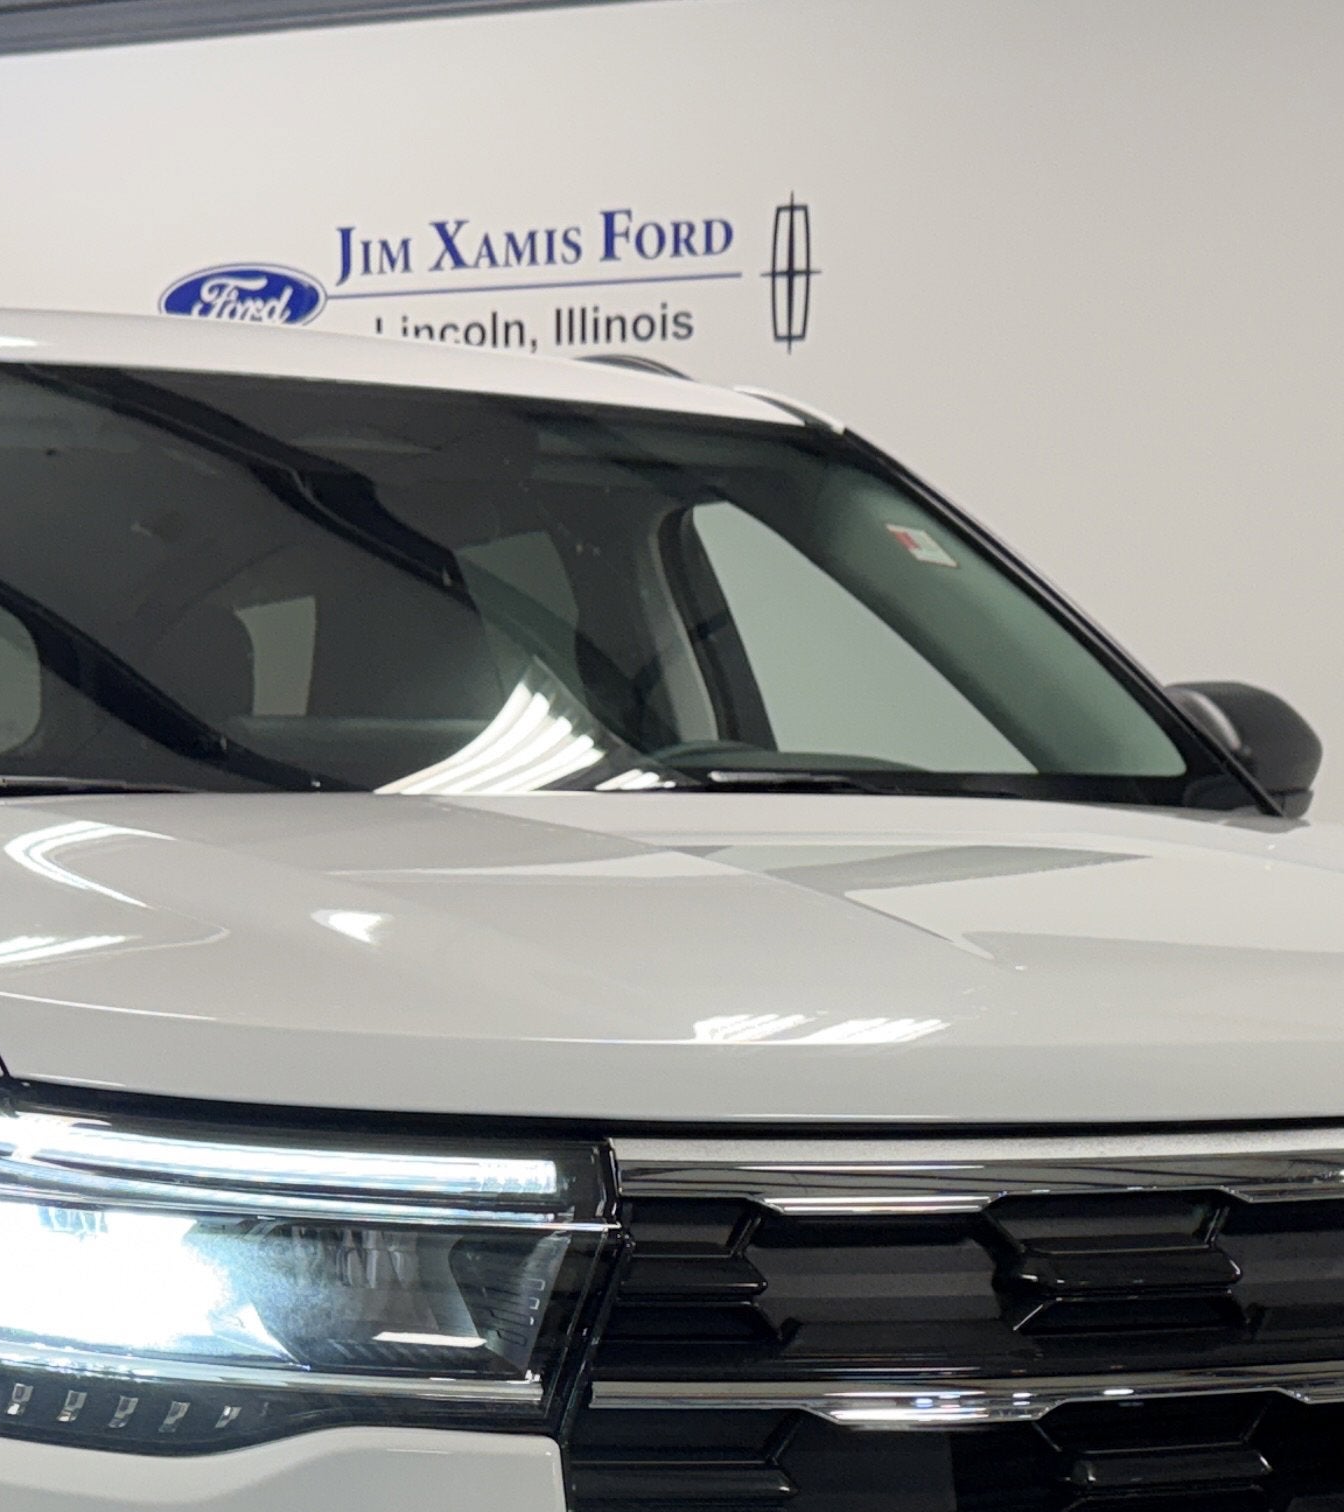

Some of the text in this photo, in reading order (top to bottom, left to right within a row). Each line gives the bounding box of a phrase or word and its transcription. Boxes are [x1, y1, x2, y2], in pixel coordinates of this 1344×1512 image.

[336, 209, 733, 286] JIM XAMIS FORD
[554, 302, 695, 347] Illinois
